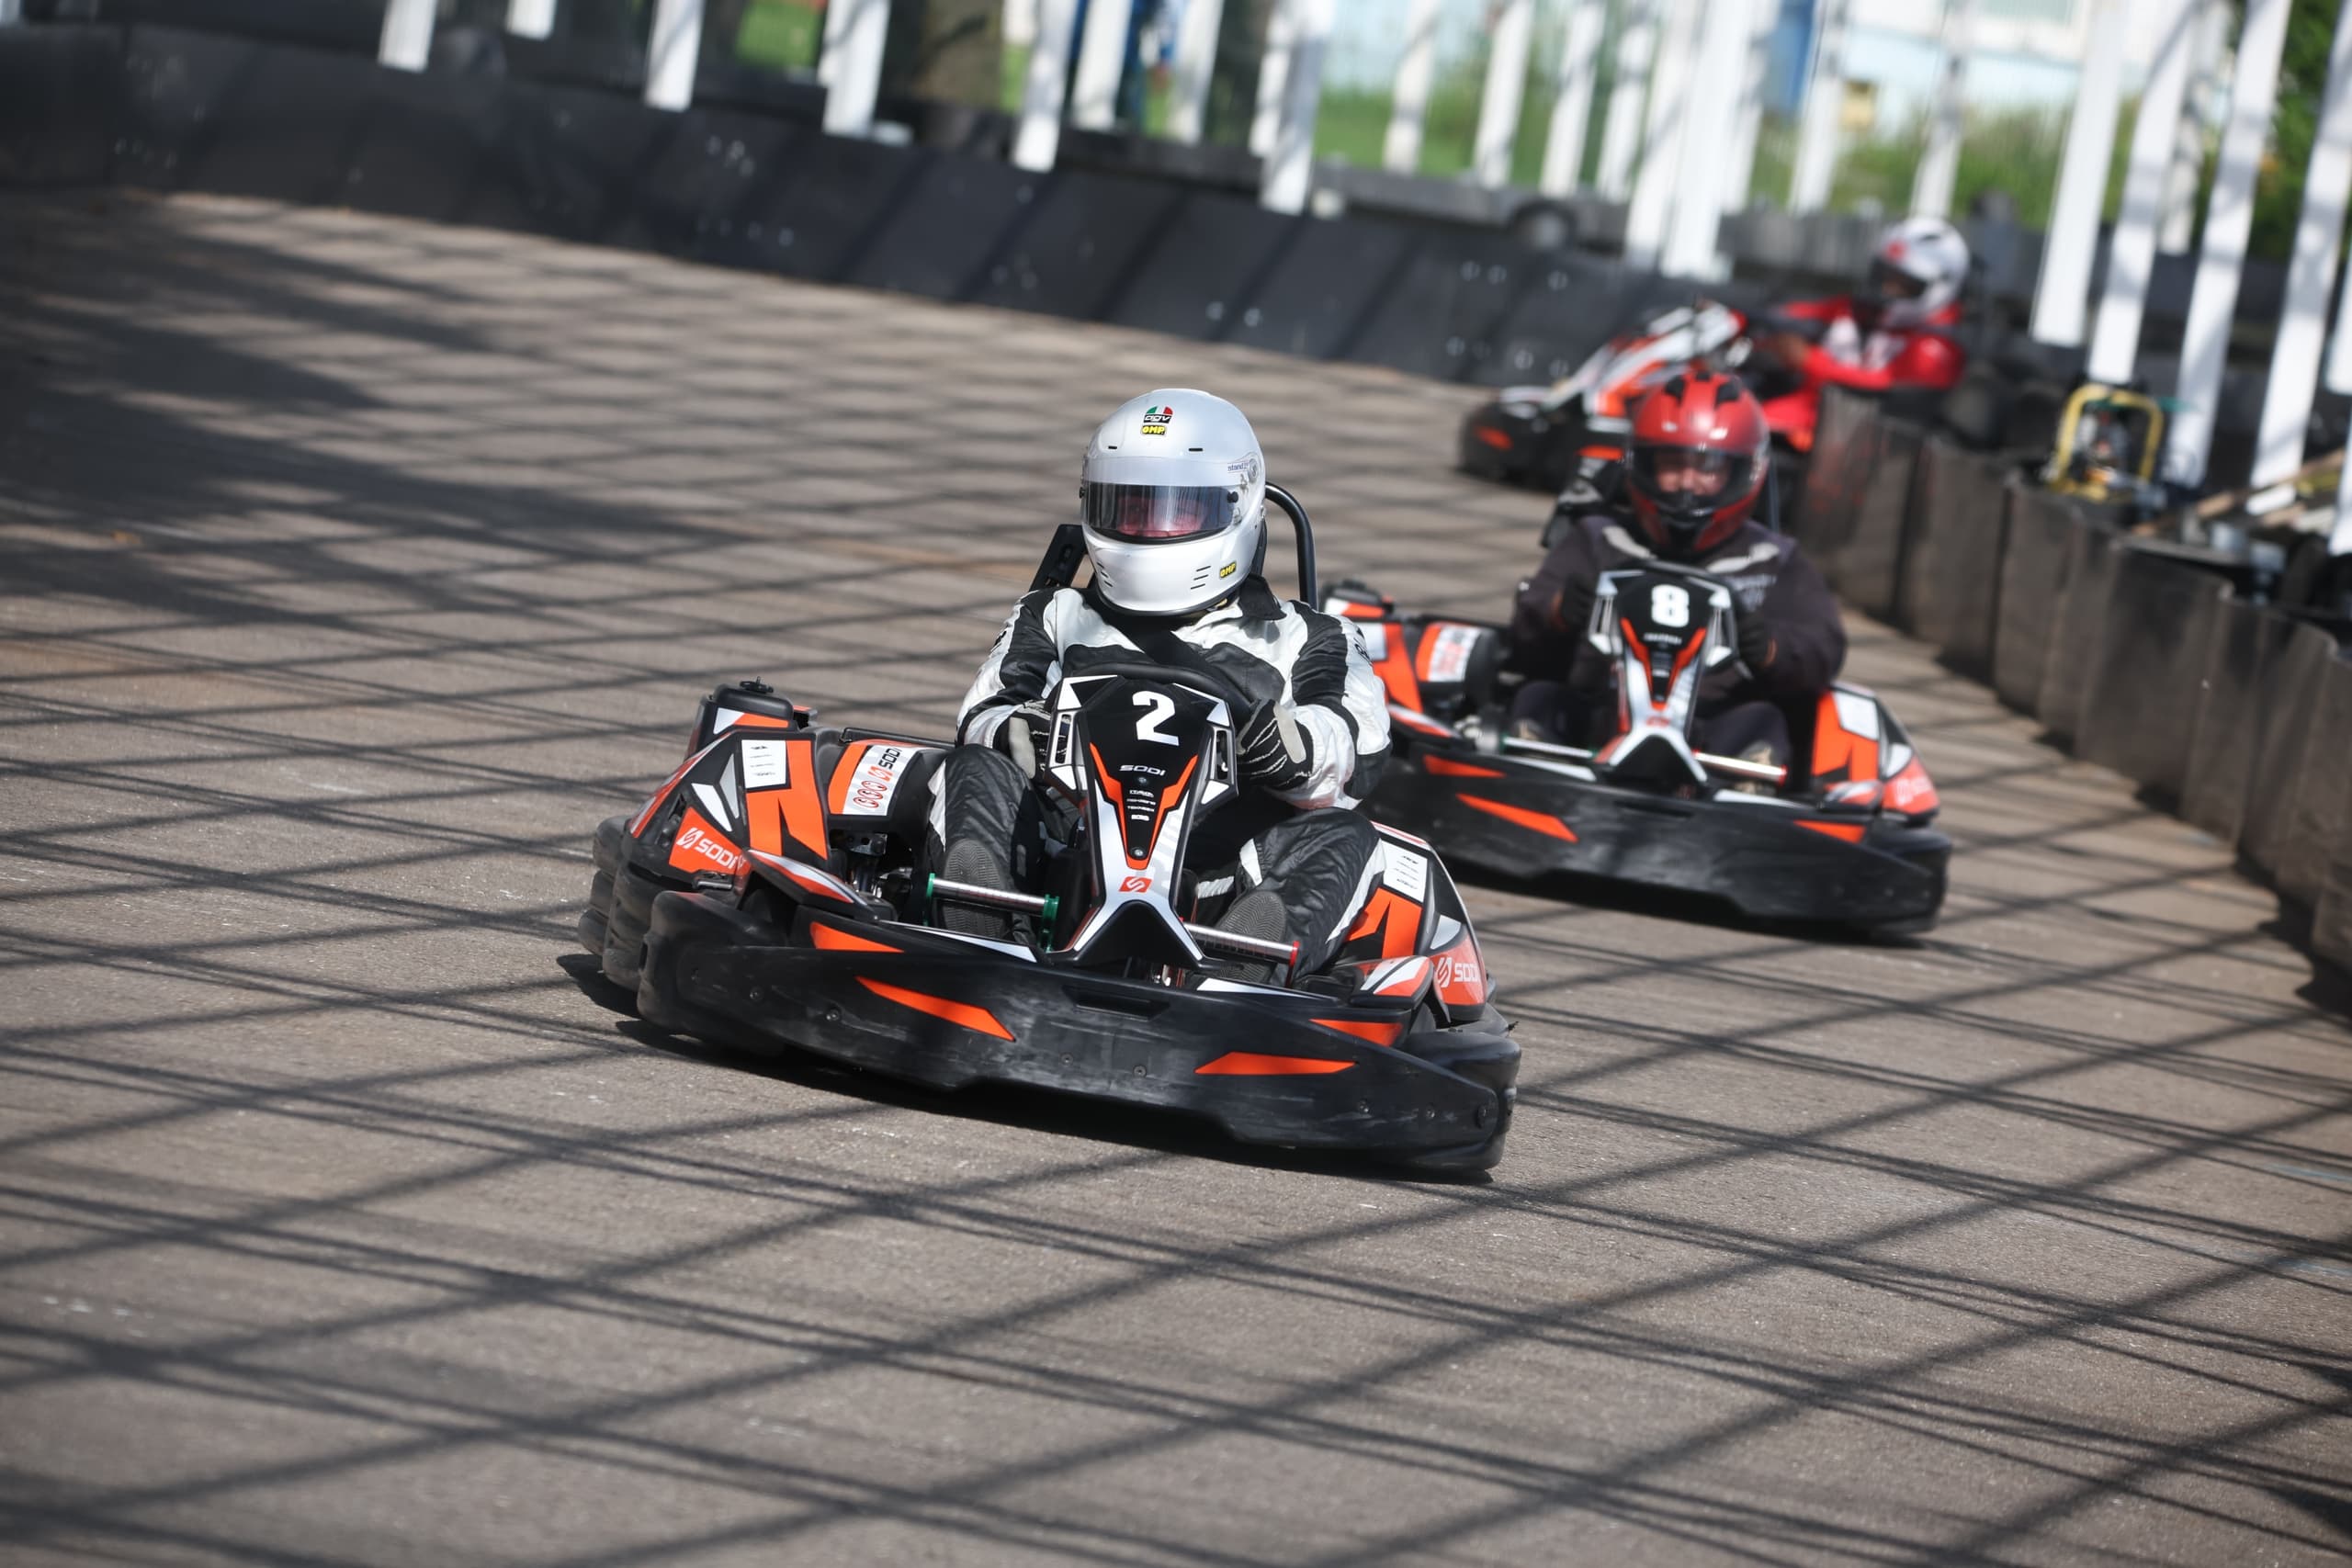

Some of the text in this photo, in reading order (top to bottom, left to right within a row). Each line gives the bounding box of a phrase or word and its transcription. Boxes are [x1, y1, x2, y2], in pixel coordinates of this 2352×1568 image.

[1142, 425, 1166, 434] OMP
[1220, 562, 1236, 578] OMP
[1651, 583, 1690, 628] 8
[1132, 690, 1180, 746] 2
[1119, 764, 1166, 776] SODI
[695, 838, 739, 870] SODI
